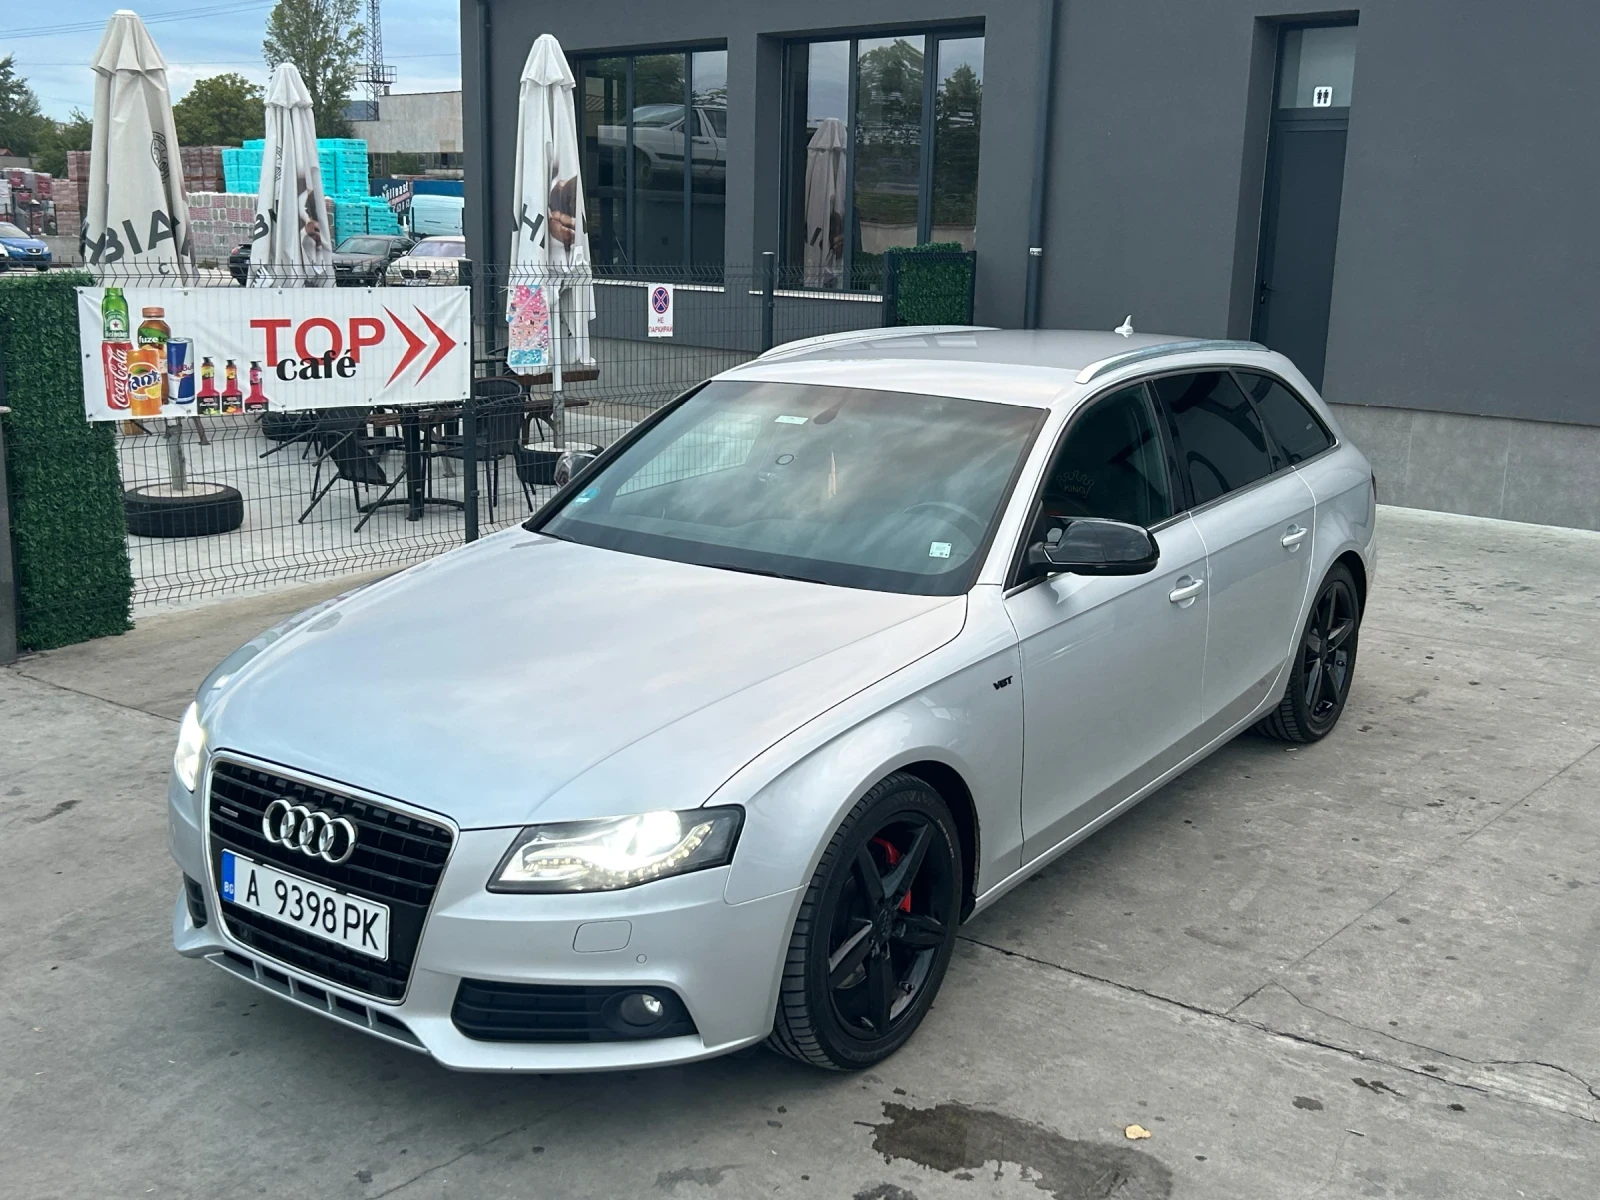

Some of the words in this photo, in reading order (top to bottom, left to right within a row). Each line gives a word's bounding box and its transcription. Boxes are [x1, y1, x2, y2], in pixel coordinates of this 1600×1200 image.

[249, 317, 386, 368] TOP
[276, 349, 357, 382] café
[1064, 484, 1086, 495] KING
[223, 881, 235, 894] BG
[245, 869, 260, 907] A
[274, 879, 337, 934] 9398
[343, 902, 380, 950] PK
